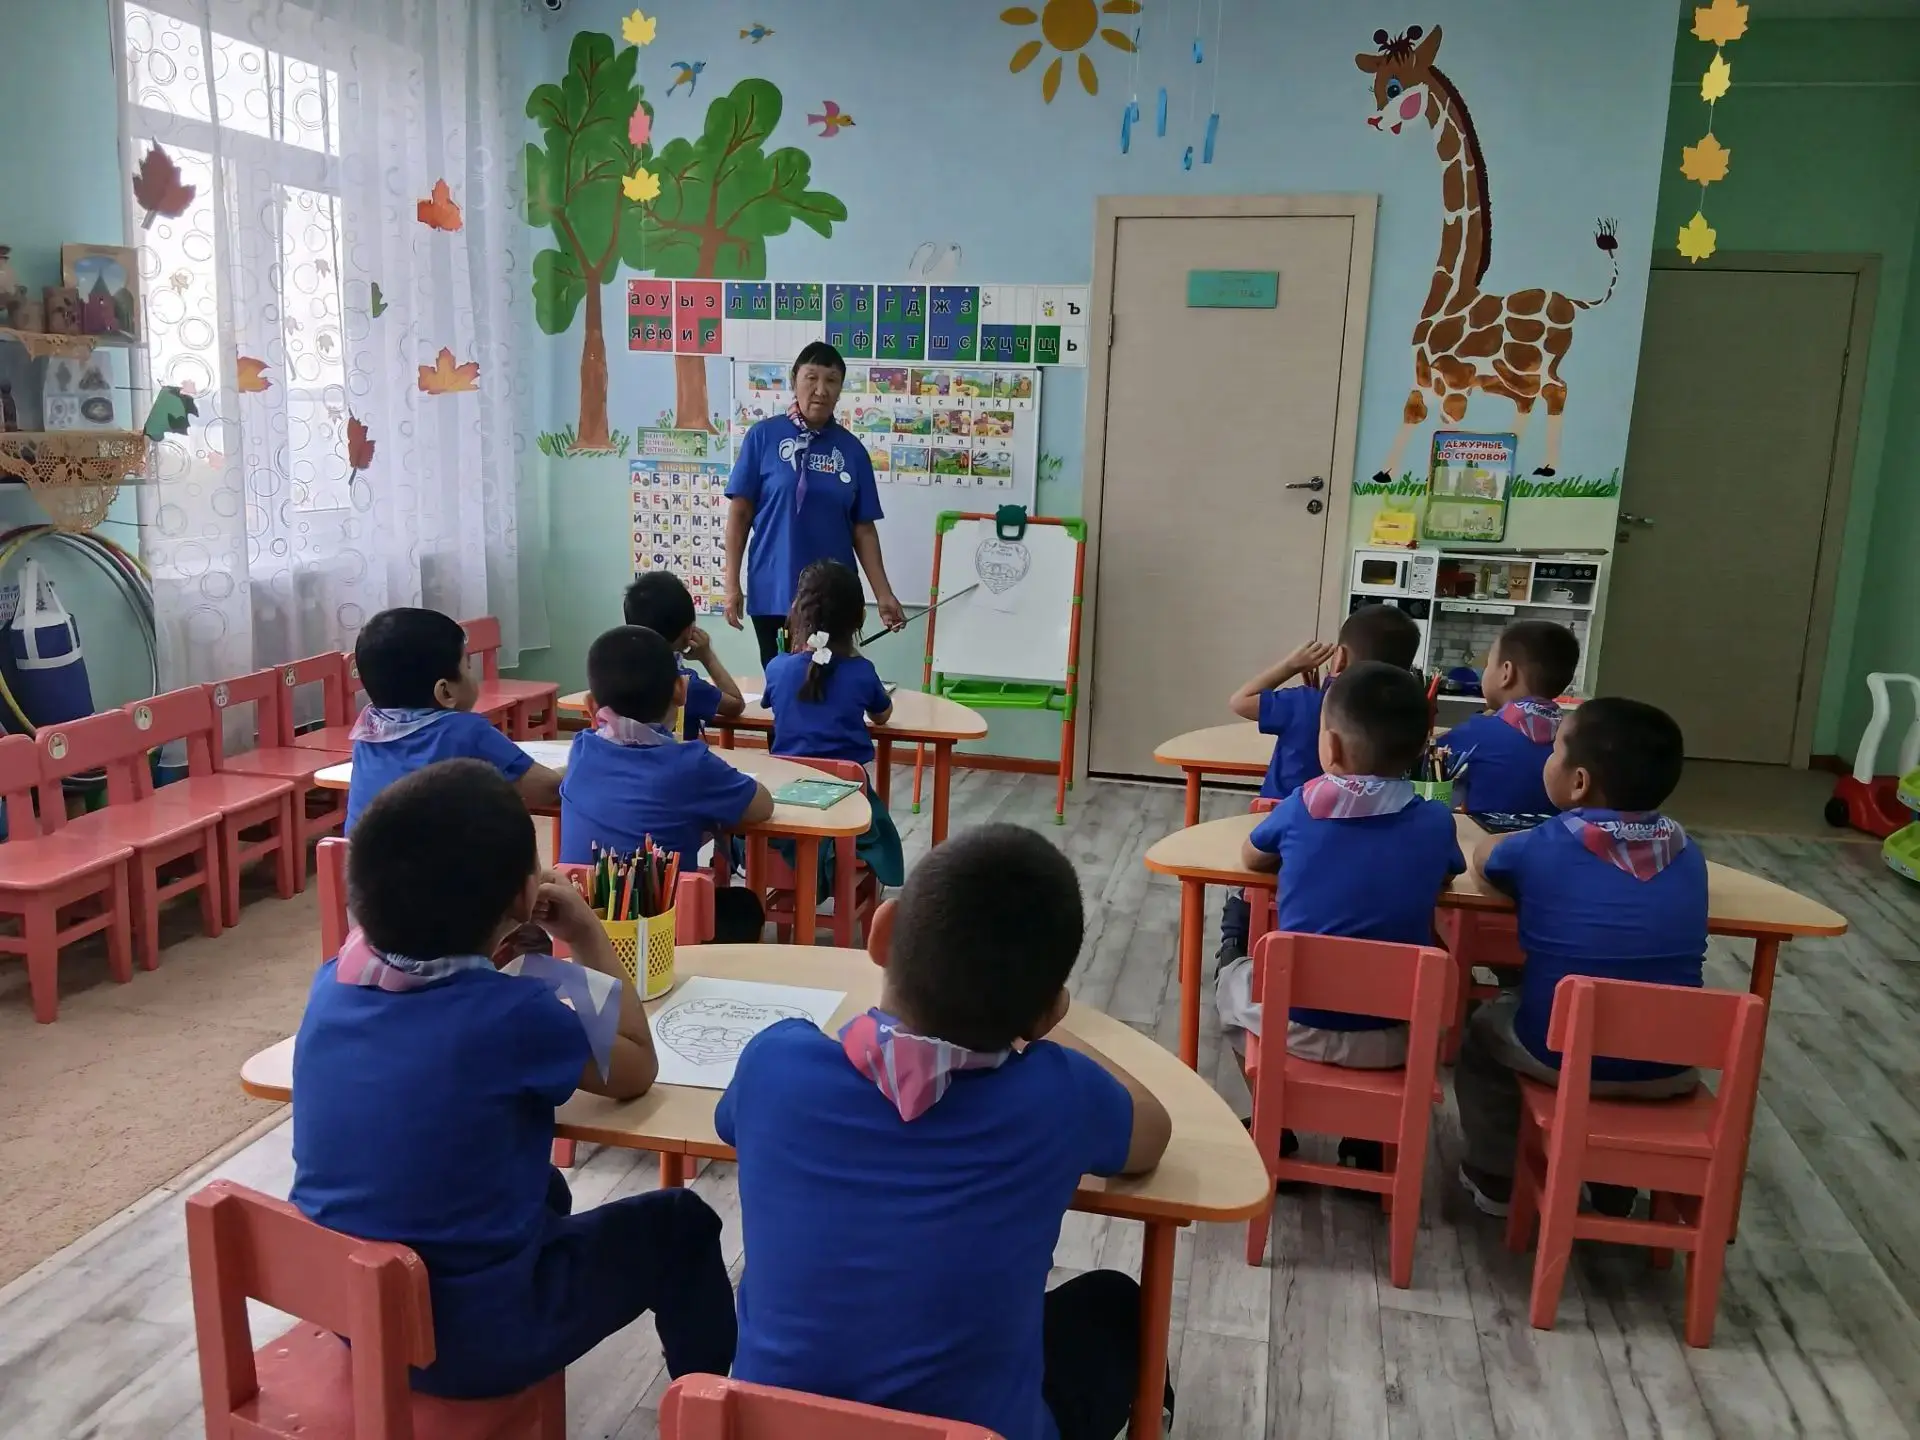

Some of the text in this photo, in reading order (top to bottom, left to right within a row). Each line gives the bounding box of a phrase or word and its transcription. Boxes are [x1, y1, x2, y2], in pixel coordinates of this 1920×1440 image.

[631, 294, 1080, 316] а о у ы э л м н р й б в г д ж з ъ
[632, 324, 1077, 354] я ё ю и е п ф к т ш с х ц ч щ ь
[1444, 440, 1502, 450] ДЕЖУРНЫЕ
[1438, 452, 1508, 462] ПО СТОЛОВОЙ
[633, 472, 720, 486] А Б В Г Д
[634, 492, 640, 502] Е
[672, 494, 682, 504] Ж
[693, 495, 700, 506] З
[712, 496, 720, 506] И
[634, 512, 720, 526] Й К Л М Н
[634, 532, 720, 546] О П Р С Т
[635, 552, 720, 568] У Ф Х Ц Ч
[692, 576, 720, 587] Ы Ь
[694, 596, 702, 606] Я
